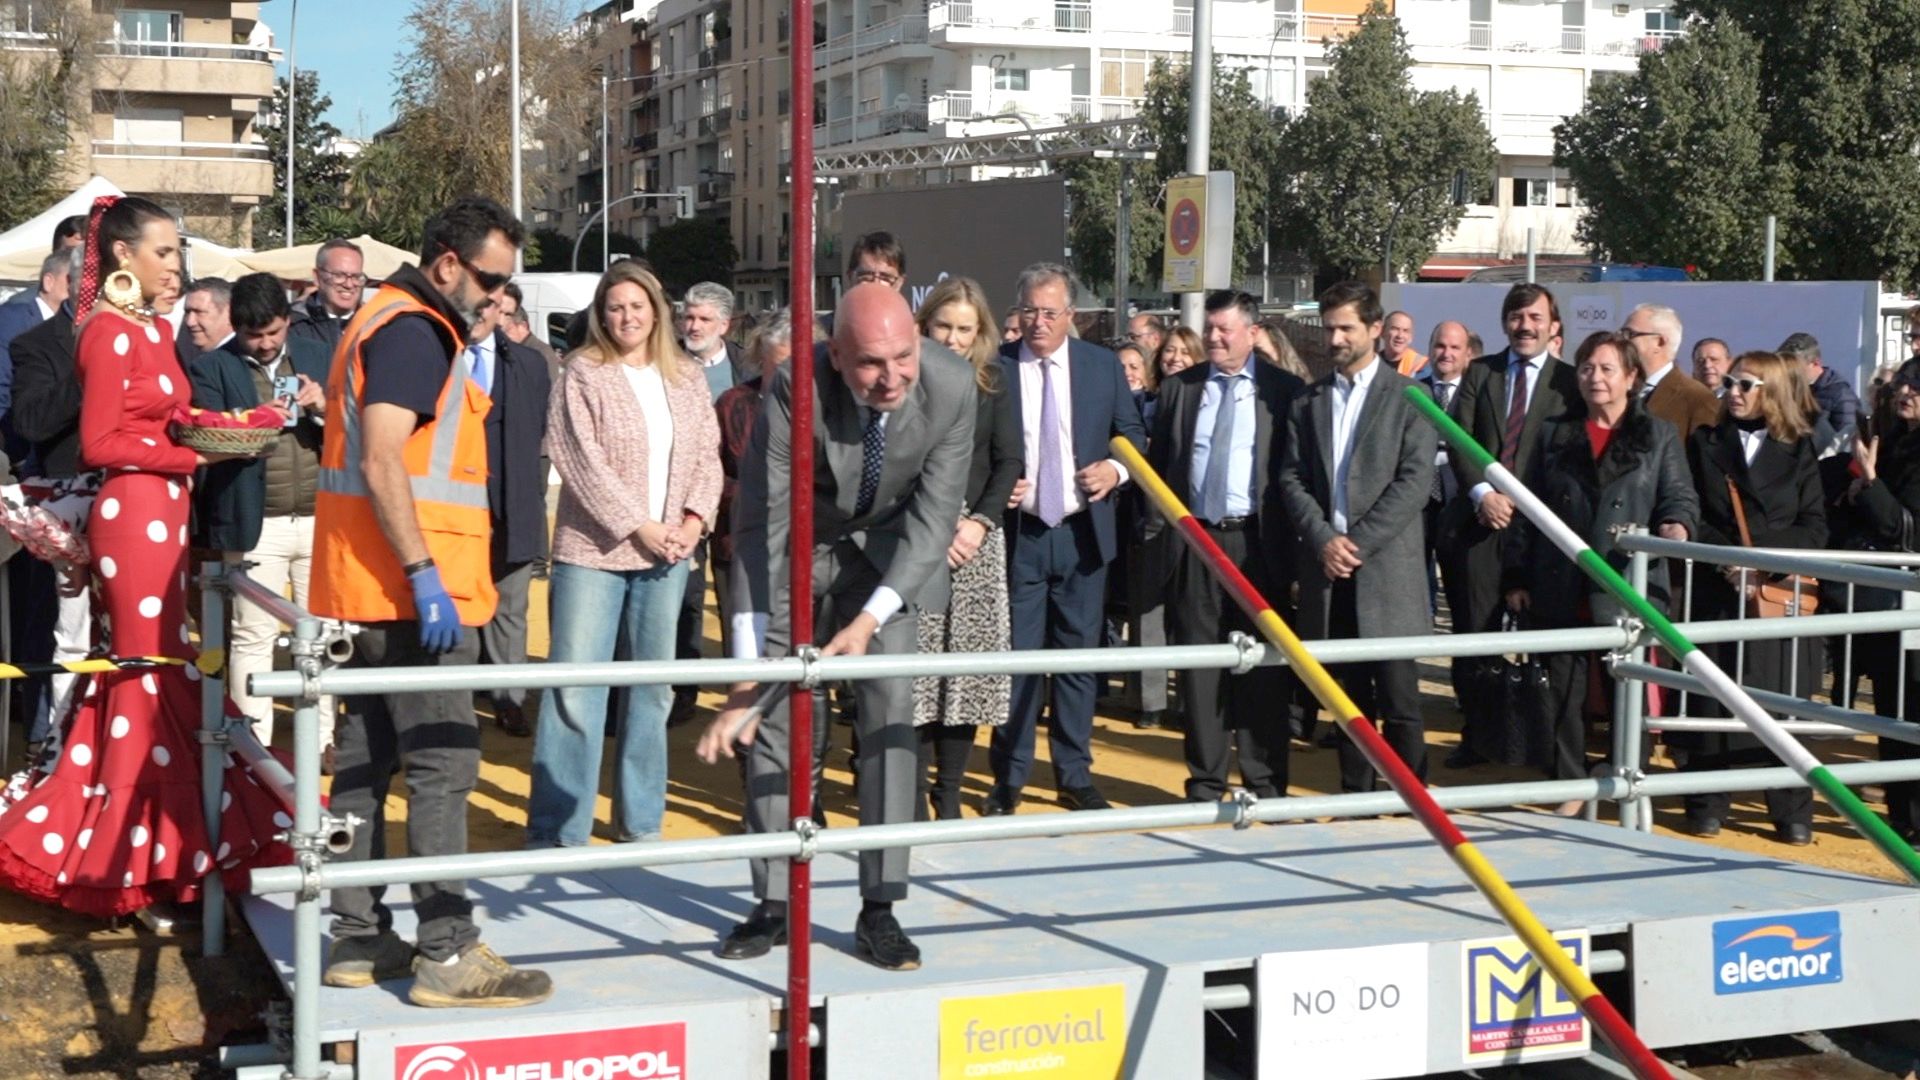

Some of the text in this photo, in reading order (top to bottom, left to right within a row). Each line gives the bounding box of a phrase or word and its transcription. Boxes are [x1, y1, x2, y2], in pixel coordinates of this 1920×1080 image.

[1720, 952, 1832, 985] elecnor
[964, 1008, 1105, 1053] ferrovial
[964, 1053, 1066, 1077] construcción
